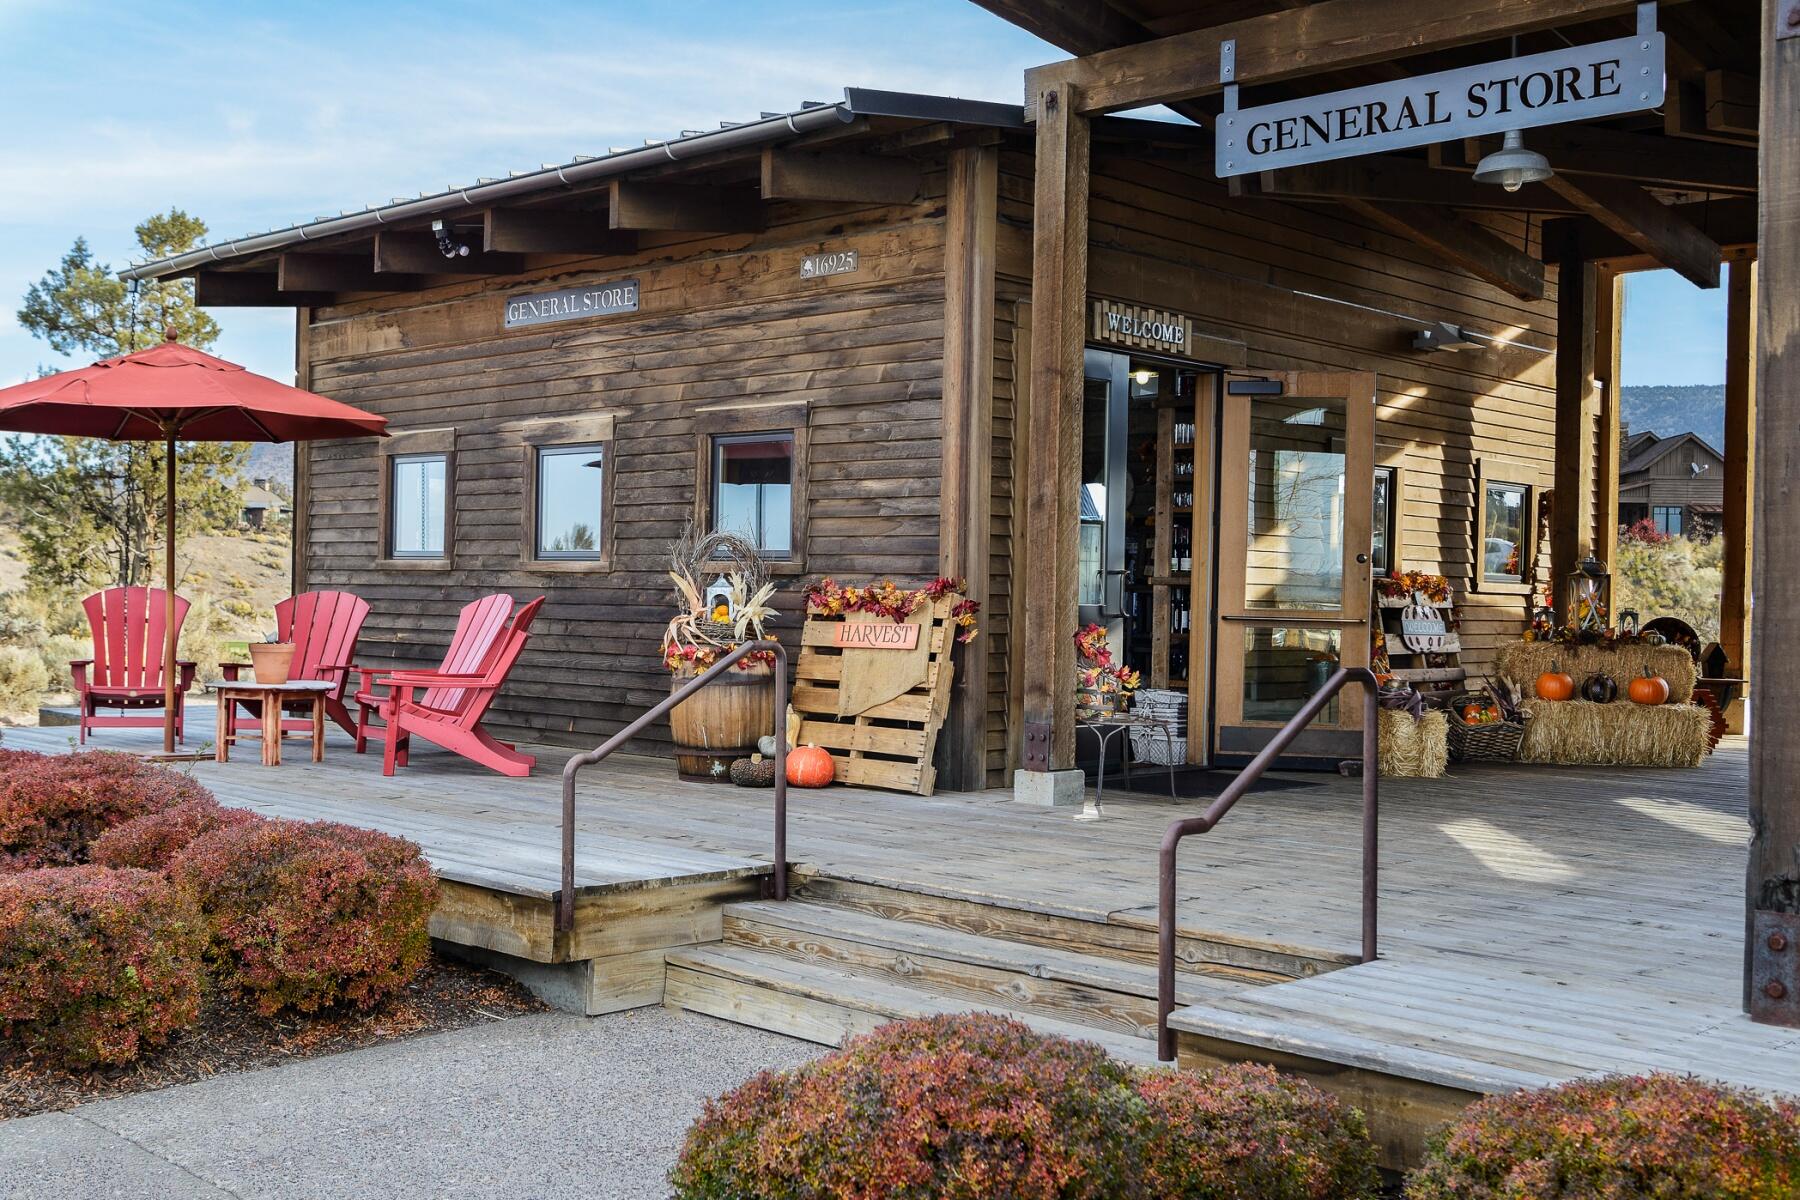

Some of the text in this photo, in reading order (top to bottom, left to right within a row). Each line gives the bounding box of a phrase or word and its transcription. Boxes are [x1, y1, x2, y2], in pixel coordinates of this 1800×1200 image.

[1246, 59, 1621, 156] GENERAL STORE
[815, 252, 853, 275] 16925
[508, 286, 634, 321] GENERAL STORE
[1106, 312, 1184, 344] WELCOME
[840, 624, 912, 647] HARVEST
[1404, 620, 1444, 634] WELCOME
